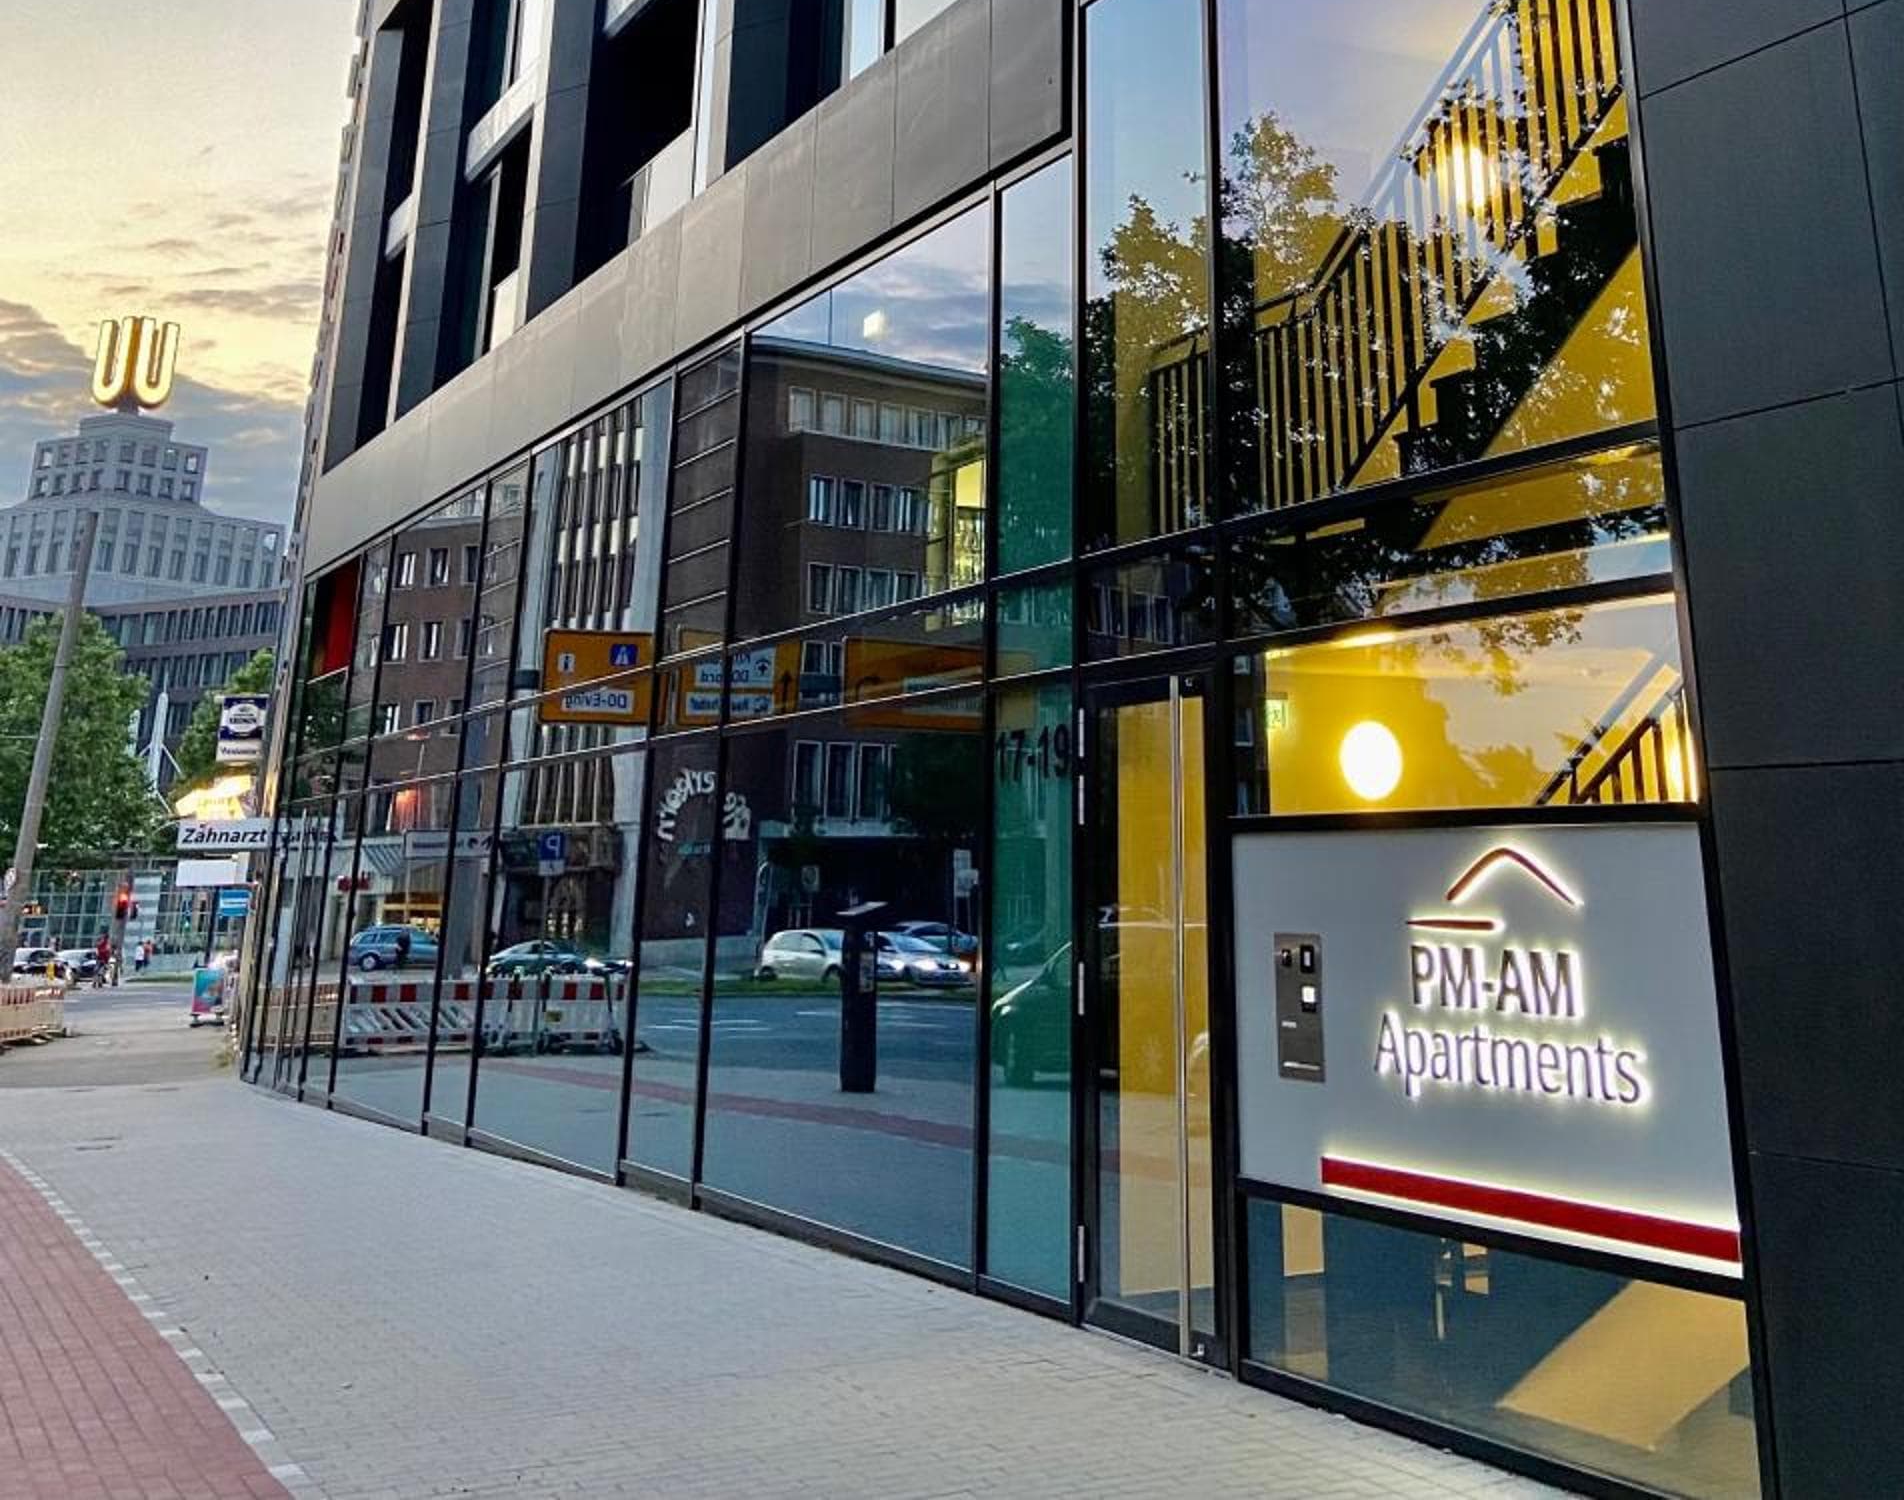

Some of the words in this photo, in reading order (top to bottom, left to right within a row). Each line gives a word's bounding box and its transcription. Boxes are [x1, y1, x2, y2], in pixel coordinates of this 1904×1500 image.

[994, 724, 1070, 783] 17-19
[1410, 945, 1577, 1017] PM-AM
[1375, 1012, 1644, 1104] Apartments
